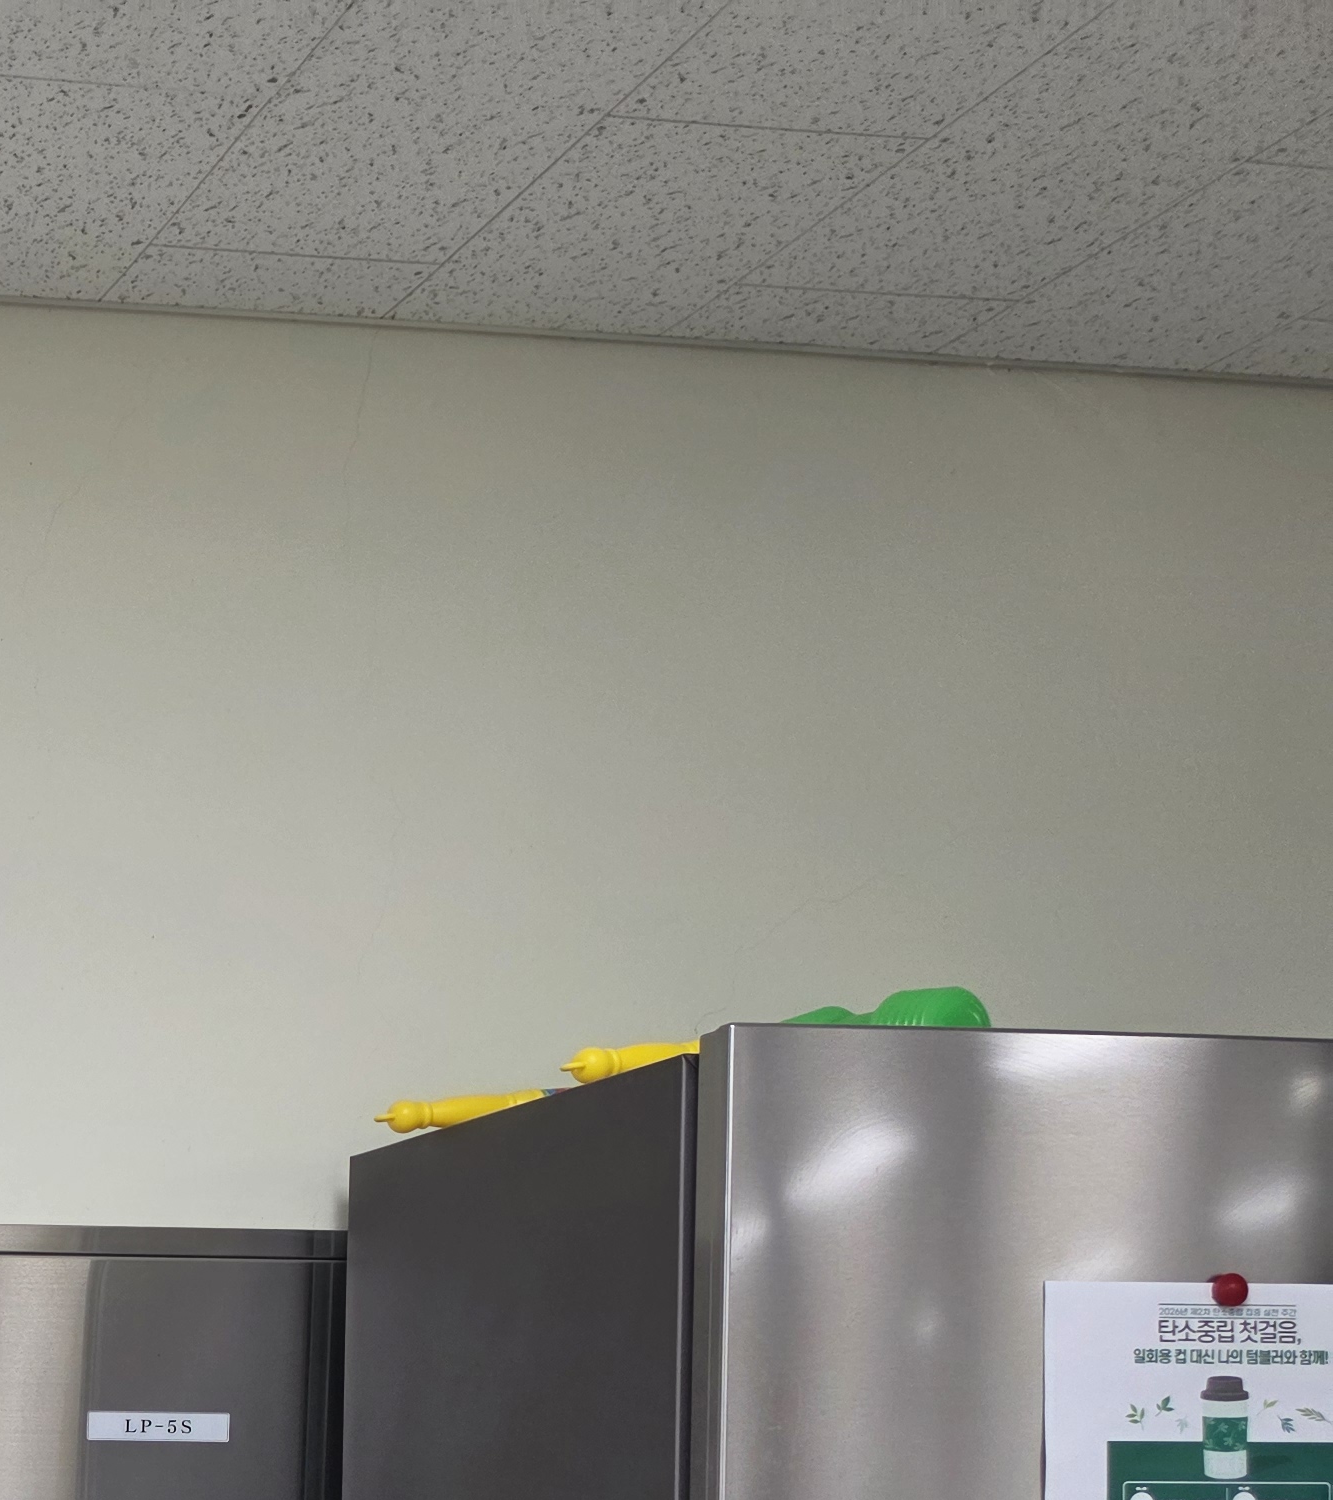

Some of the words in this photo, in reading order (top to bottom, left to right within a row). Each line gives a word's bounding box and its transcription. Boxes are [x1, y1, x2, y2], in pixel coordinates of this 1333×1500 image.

[1158, 1319, 1235, 1344] 탄소중립
[1239, 1320, 1302, 1346] 첫걸음,
[1133, 1348, 1172, 1364] 일회용
[1174, 1349, 1187, 1364] 컵
[1189, 1349, 1215, 1365] 대신
[1217, 1350, 1243, 1365] 나의
[1246, 1350, 1298, 1366] 텀블러와
[1299, 1351, 1329, 1366] 함께!
[124, 1419, 193, 1435] LP-5S
